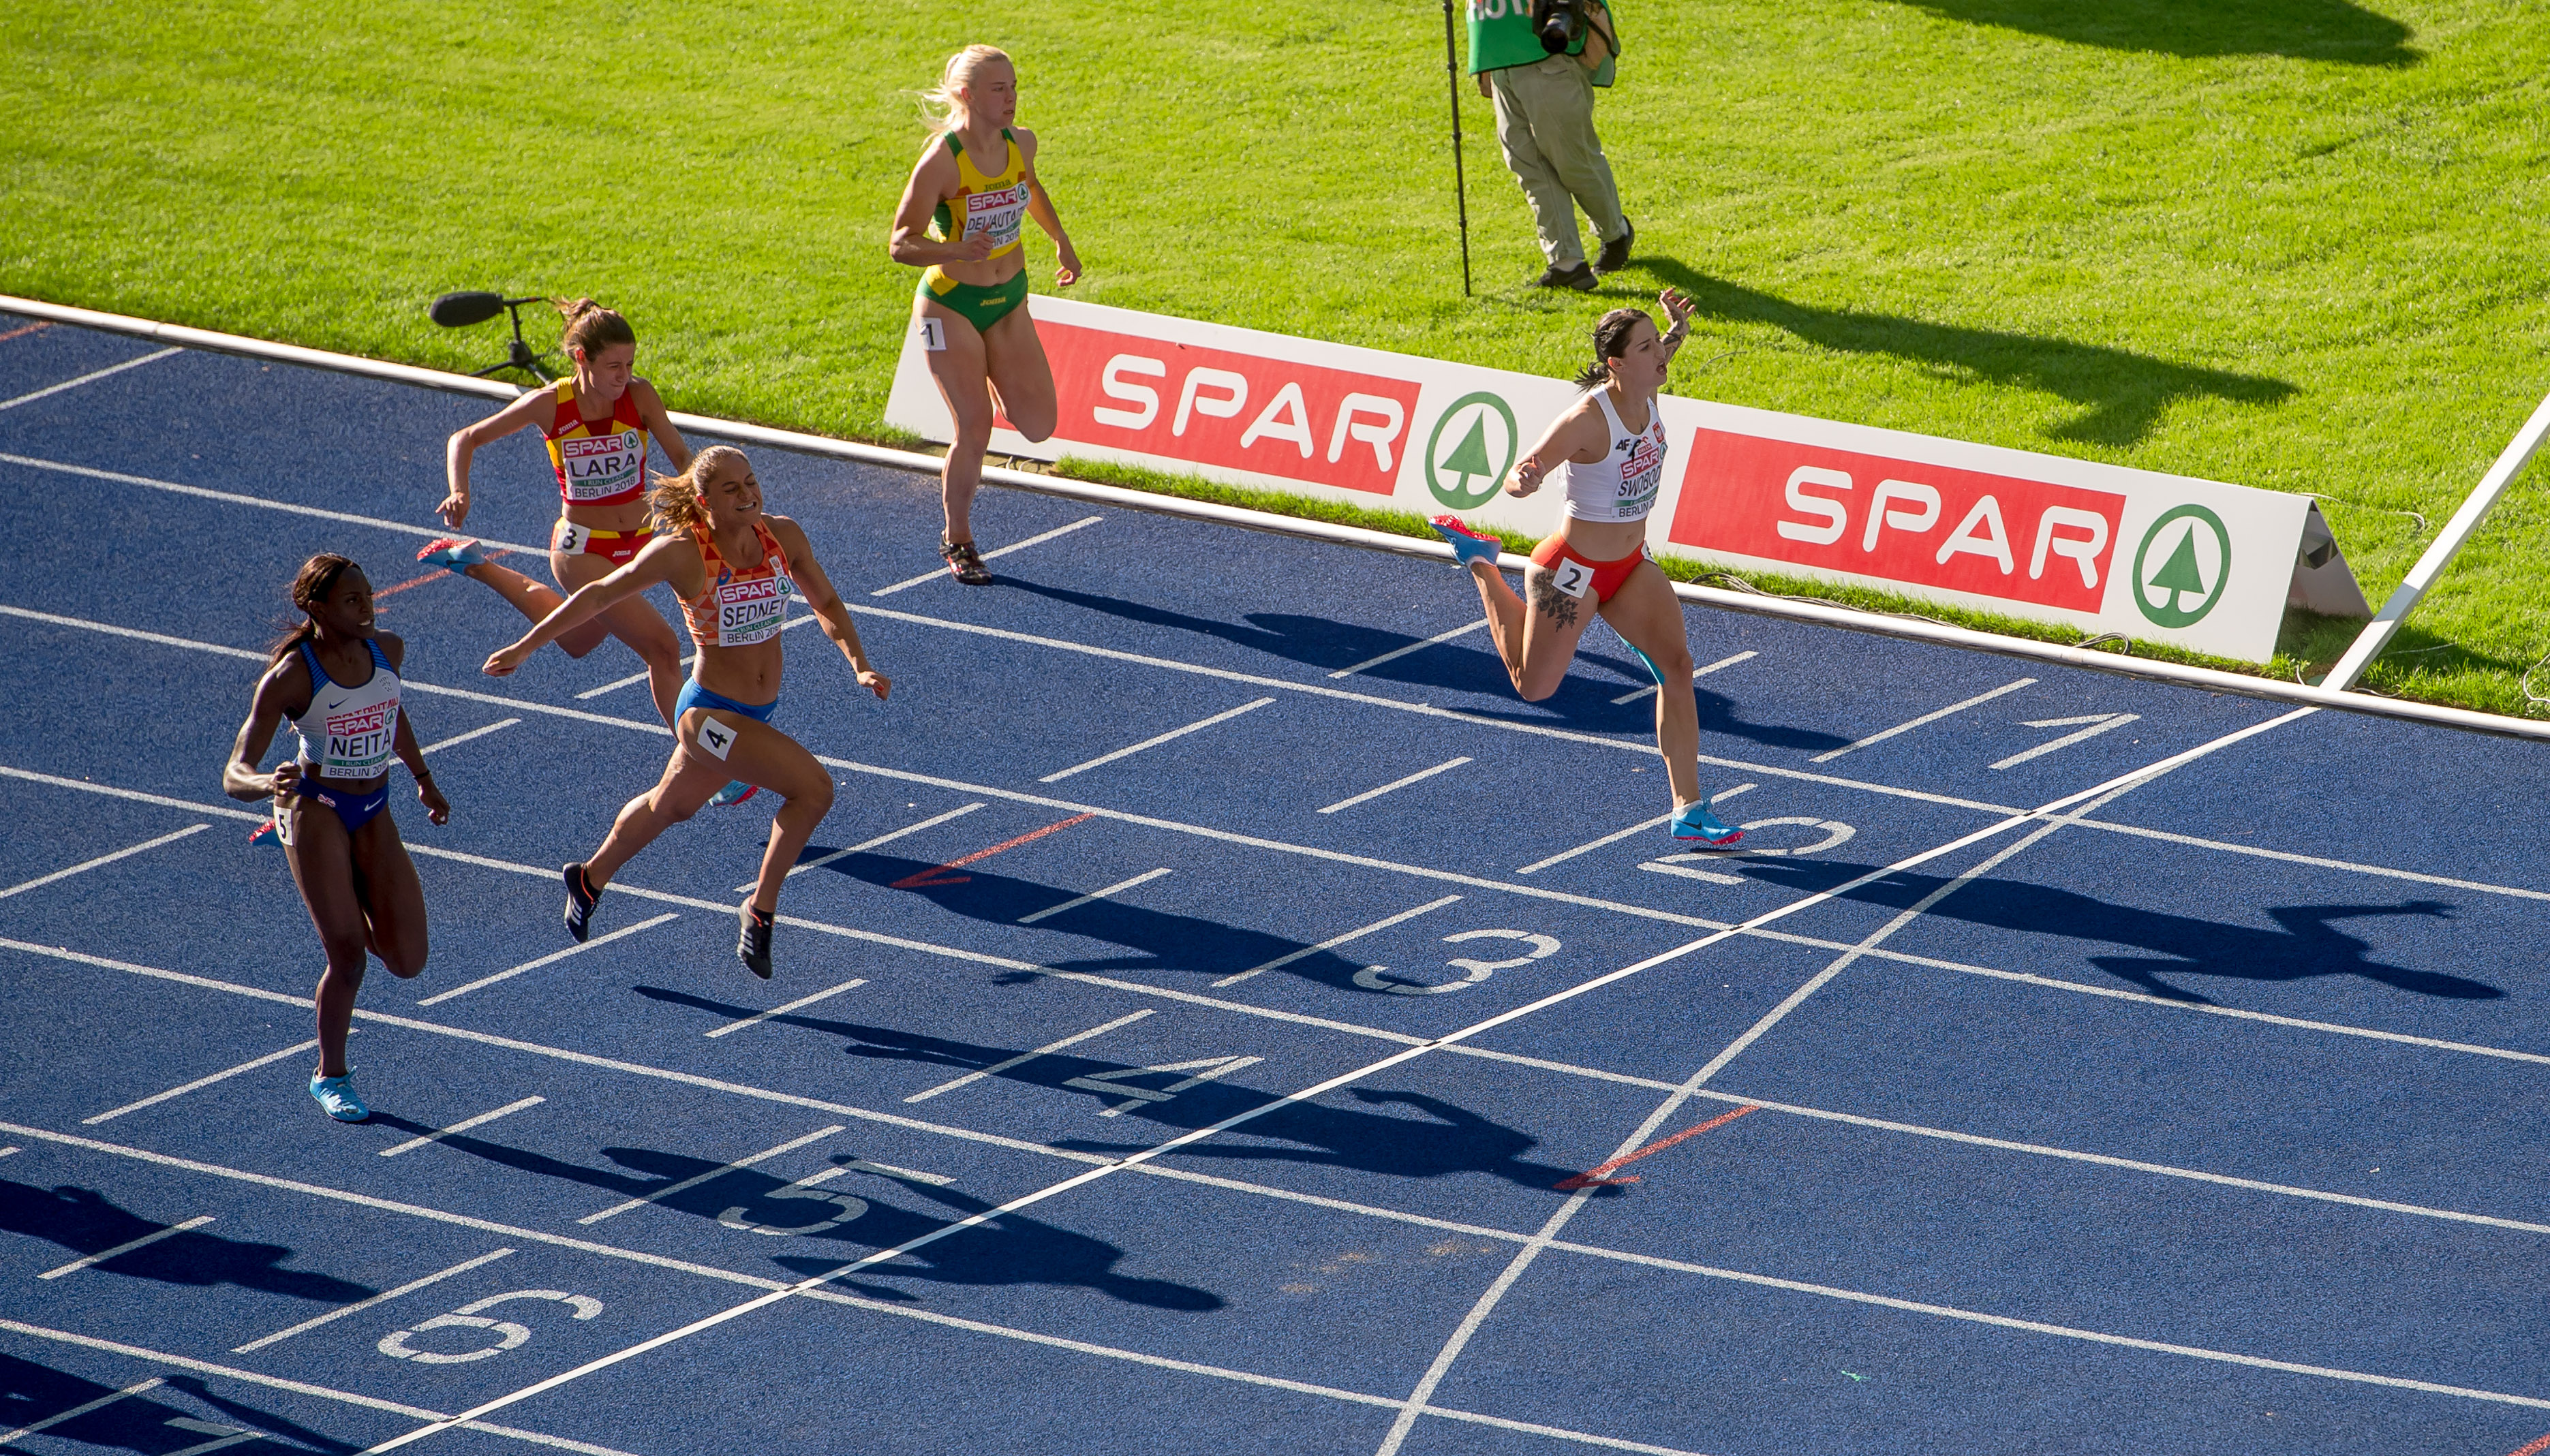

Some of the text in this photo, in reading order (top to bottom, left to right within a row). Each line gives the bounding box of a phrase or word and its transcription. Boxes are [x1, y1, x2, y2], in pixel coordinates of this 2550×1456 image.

[970, 191, 1017, 210] SPAR
[1093, 353, 1404, 473] SPAR
[565, 438, 621, 456] SPAR
[570, 452, 636, 477] LARA
[1622, 450, 1659, 477] SPAR
[575, 476, 635, 497] BERLIN 2018
[1618, 465, 1661, 497] SWOBOD
[1619, 501, 1649, 518] BERLIN
[562, 528, 577, 550] 3
[1777, 465, 2108, 589] SPAR
[722, 581, 775, 602] SPAR
[1562, 567, 1582, 592] 2
[723, 598, 787, 628] SEDNEY
[727, 630, 764, 643] BERLIN
[329, 715, 382, 735] SPAR
[330, 728, 390, 757] NEITA
[705, 728, 728, 749] 4
[1988, 713, 2141, 770] 1
[329, 767, 369, 776] BERLIN
[279, 814, 287, 839] 5
[1637, 816, 1856, 885] 2
[1352, 928, 1562, 995] 3
[1062, 1055, 1265, 1117] 4
[718, 1160, 957, 1236] 5
[377, 1288, 604, 1364] 6
